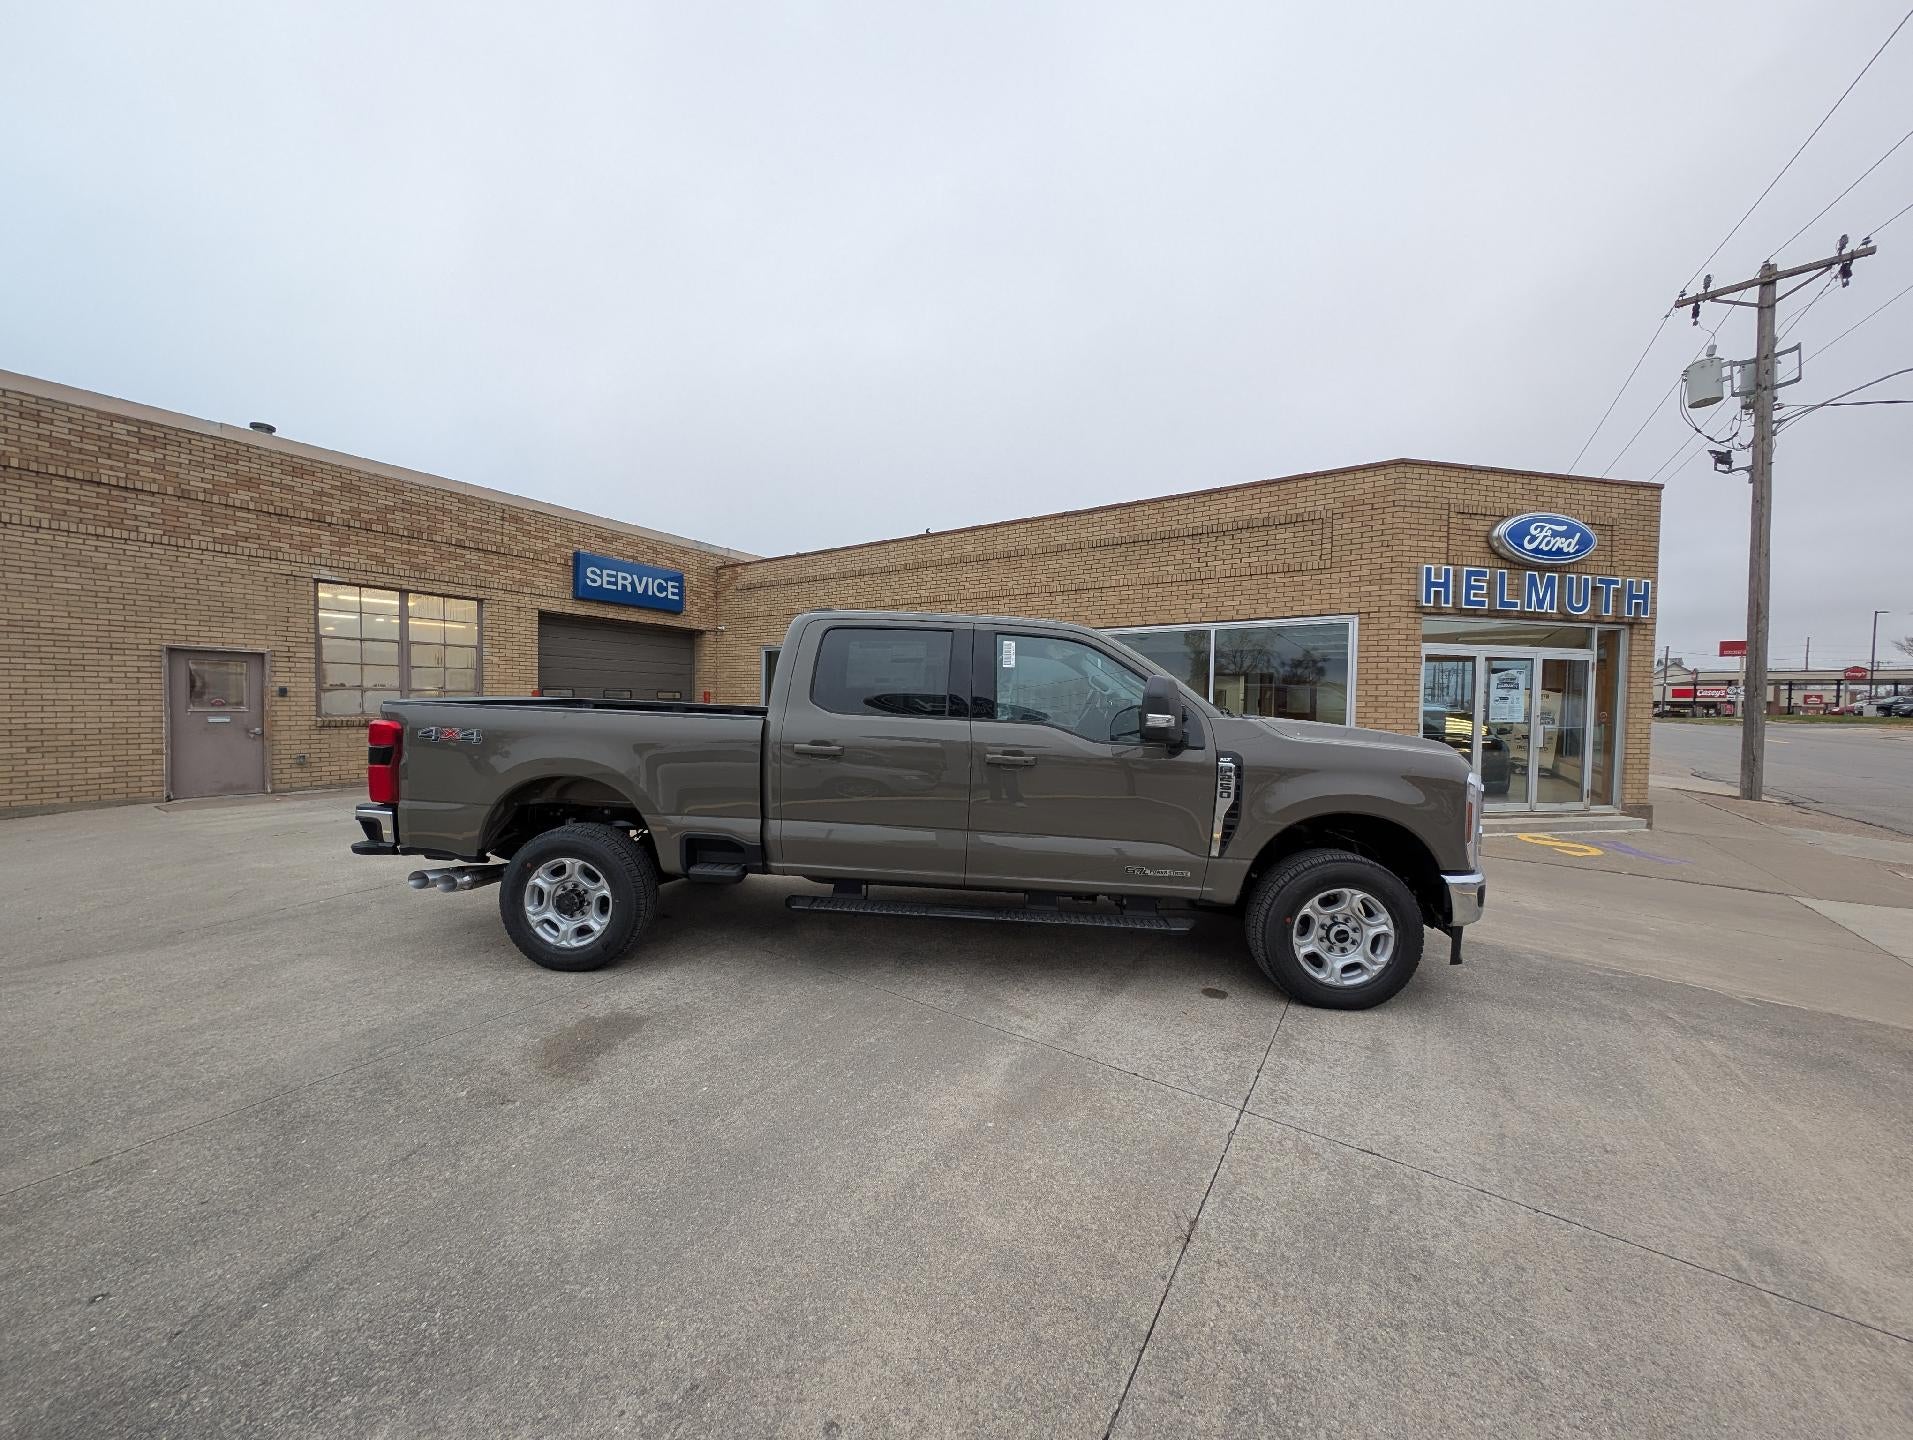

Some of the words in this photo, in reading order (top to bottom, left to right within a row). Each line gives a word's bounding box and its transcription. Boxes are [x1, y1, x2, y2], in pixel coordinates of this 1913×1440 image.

[1523, 522, 1579, 553] Ford
[586, 566, 680, 600] SERVICE
[1421, 565, 1652, 618] HELMUTH
[1696, 689, 1726, 698] Casey's
